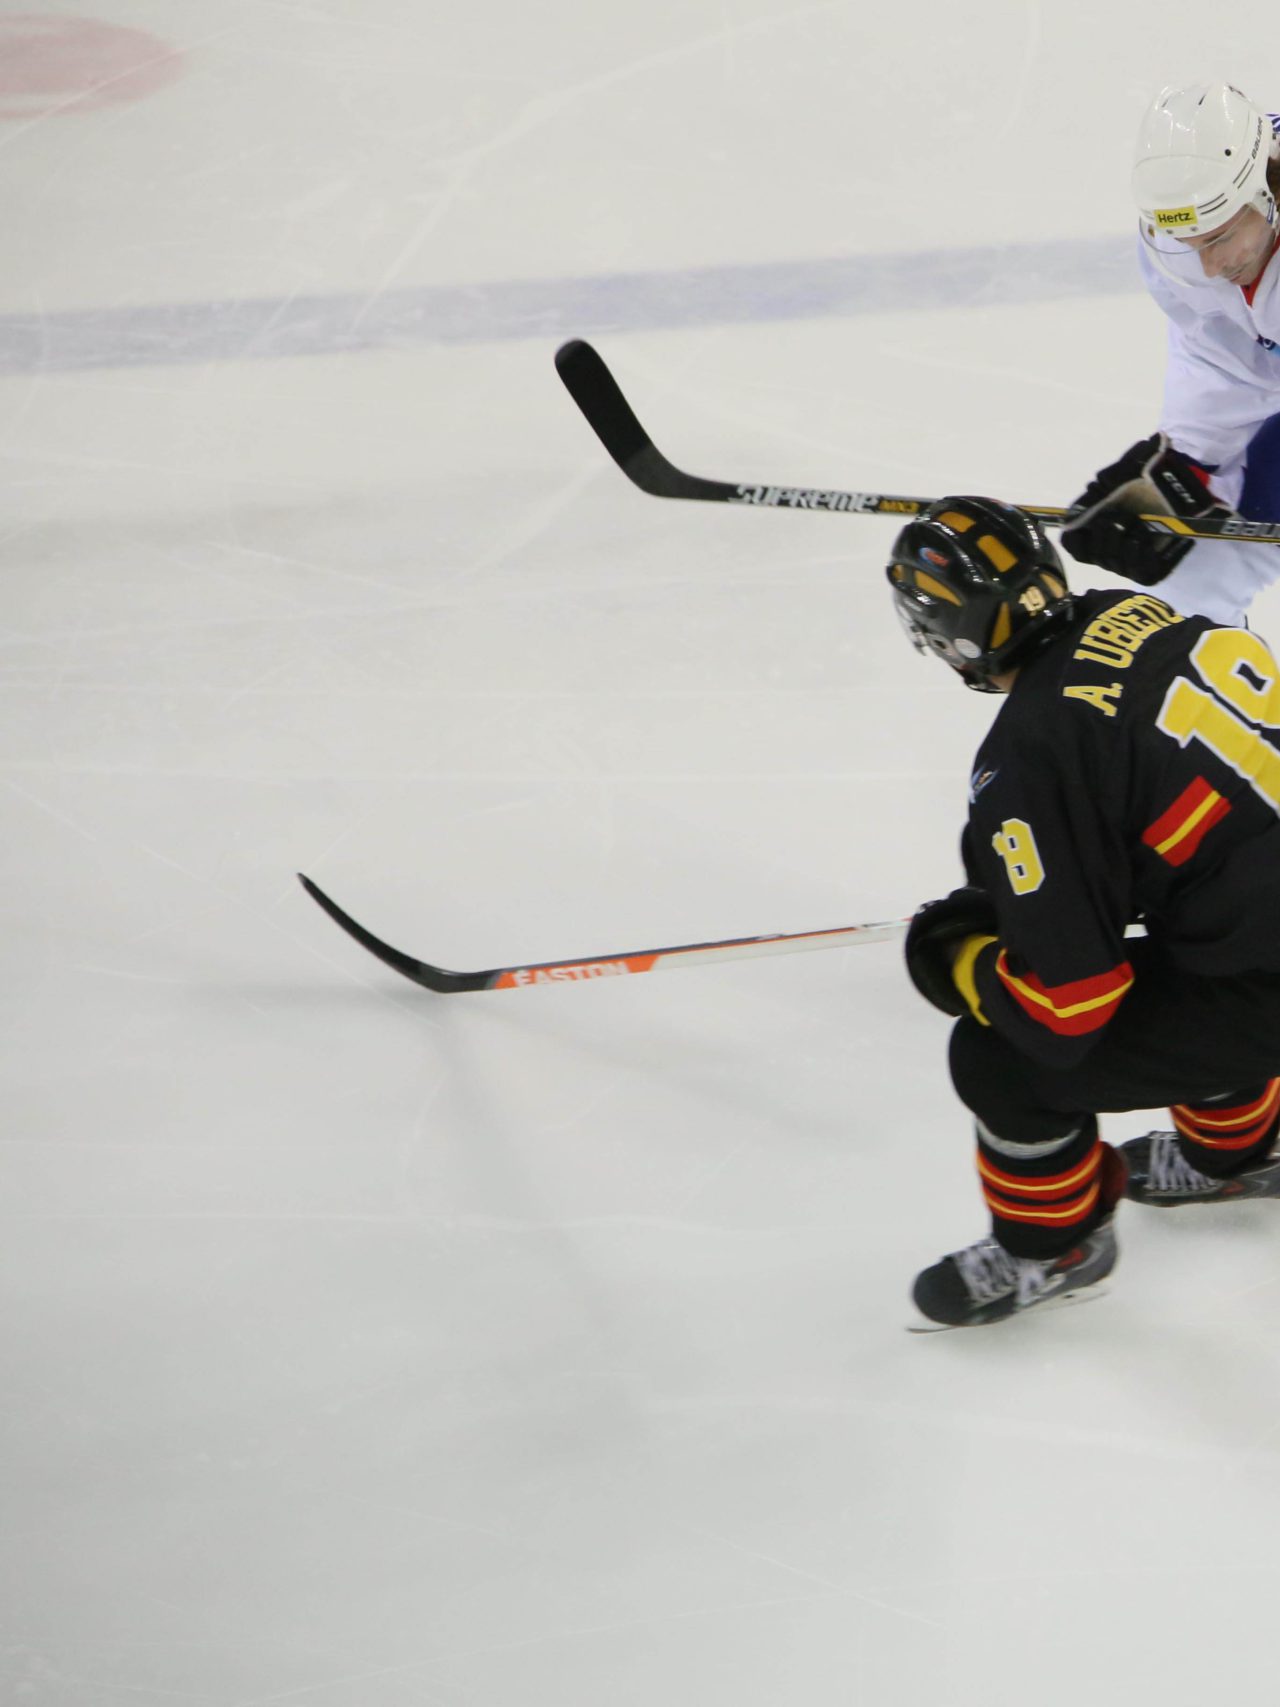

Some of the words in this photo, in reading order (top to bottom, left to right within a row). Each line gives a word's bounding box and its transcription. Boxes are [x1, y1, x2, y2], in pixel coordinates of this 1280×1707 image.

[1158, 211, 1192, 223] Hertz
[729, 483, 879, 513] SUPREME
[1063, 682, 1123, 717] A.
[511, 960, 628, 988] EASTON
